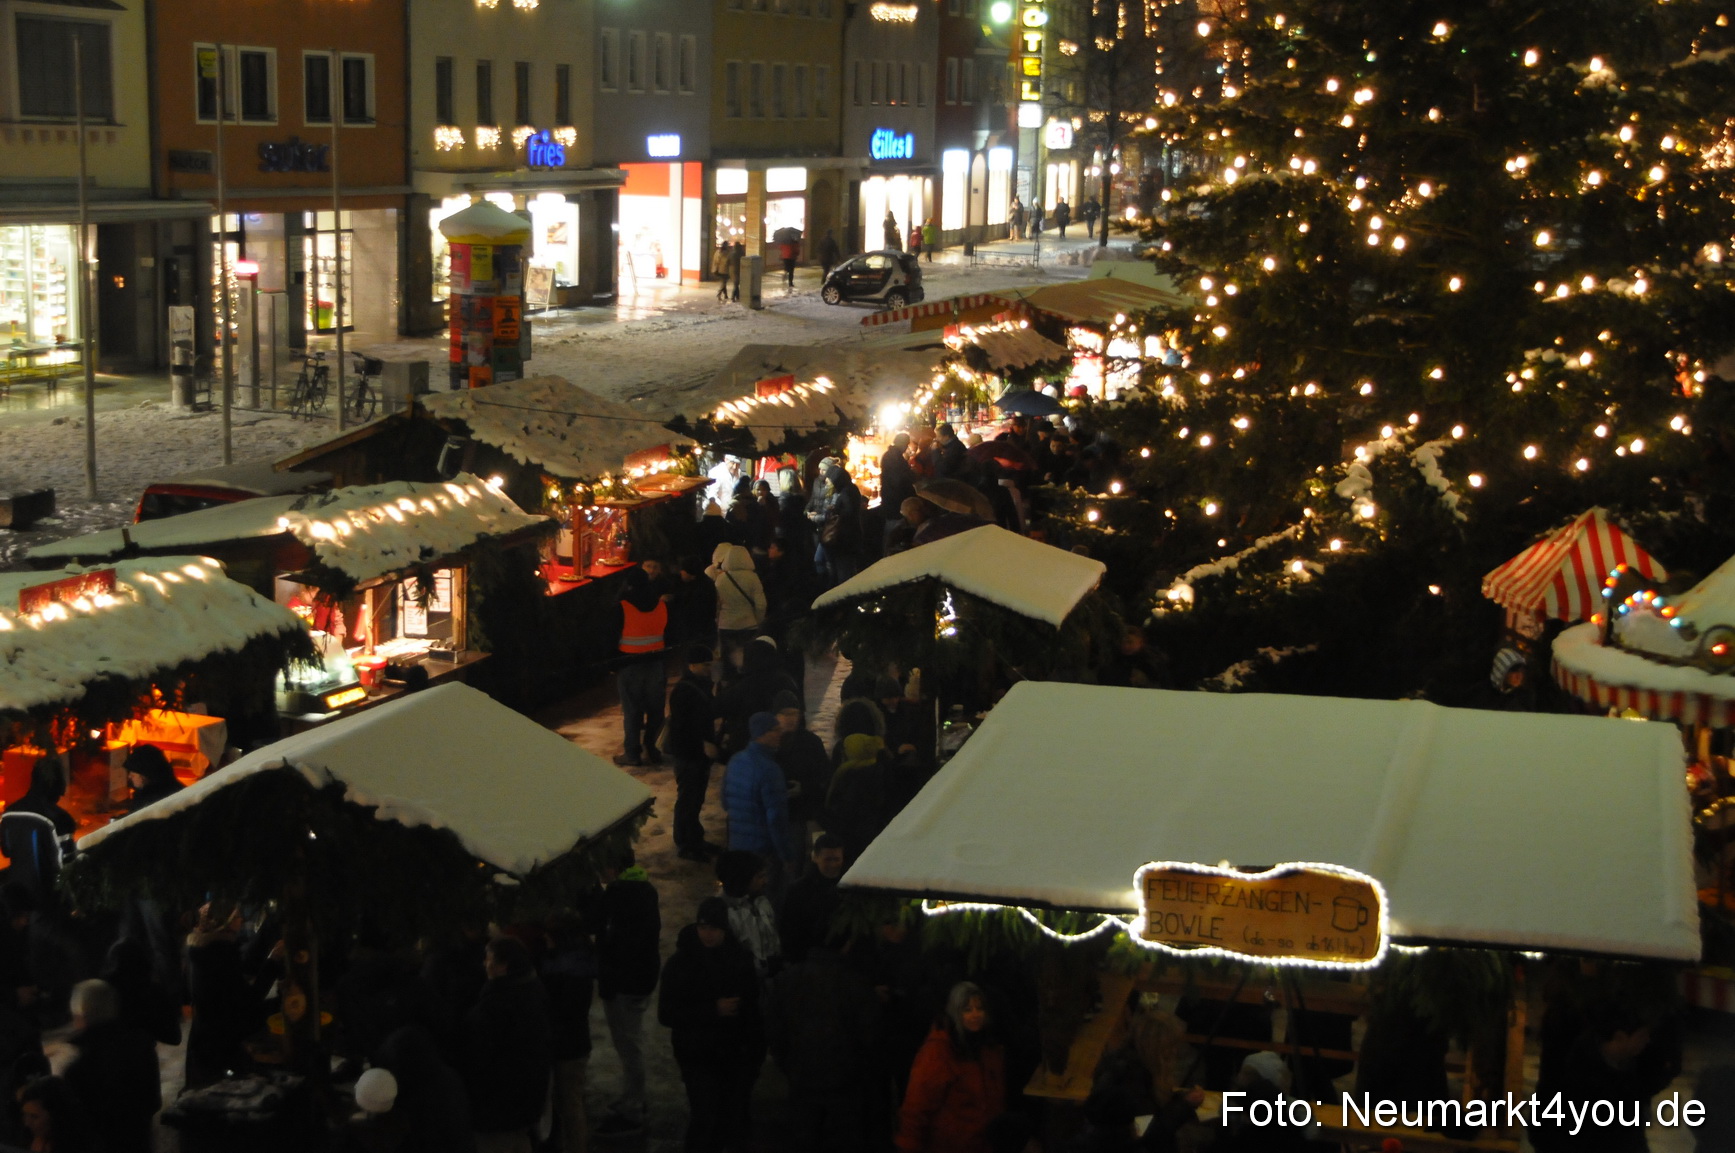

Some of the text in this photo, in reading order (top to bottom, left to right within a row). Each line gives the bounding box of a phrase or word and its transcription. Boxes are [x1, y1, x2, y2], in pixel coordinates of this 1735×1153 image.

[1021, 0, 1045, 101] OTEL
[1147, 878, 1323, 914] FEUERZANGEN-
[1148, 911, 1225, 941] BOWLE
